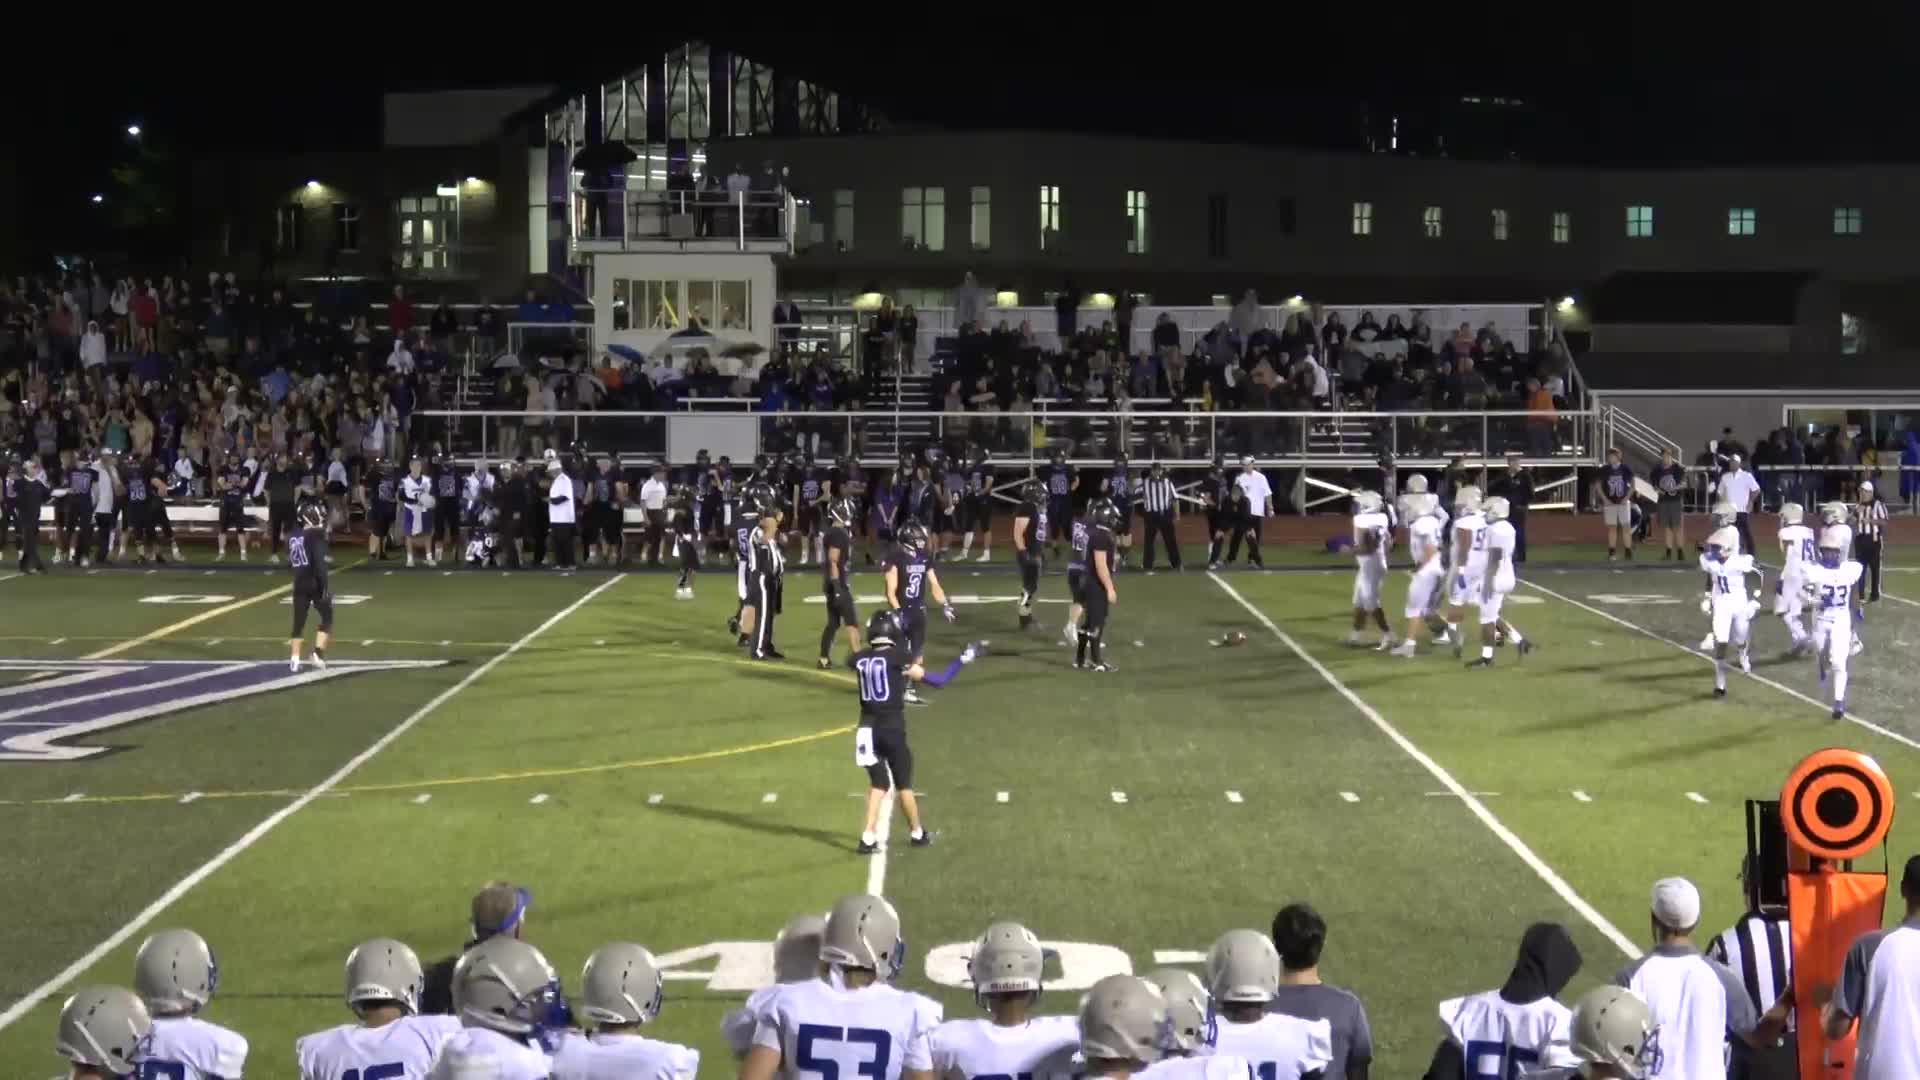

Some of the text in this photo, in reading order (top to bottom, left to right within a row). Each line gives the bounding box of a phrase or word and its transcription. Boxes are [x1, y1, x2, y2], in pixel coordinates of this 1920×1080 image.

[289, 536, 309, 567] 21
[1717, 575, 1730, 594] 11
[856, 656, 890, 701] 10
[797, 1024, 891, 1080] 53
